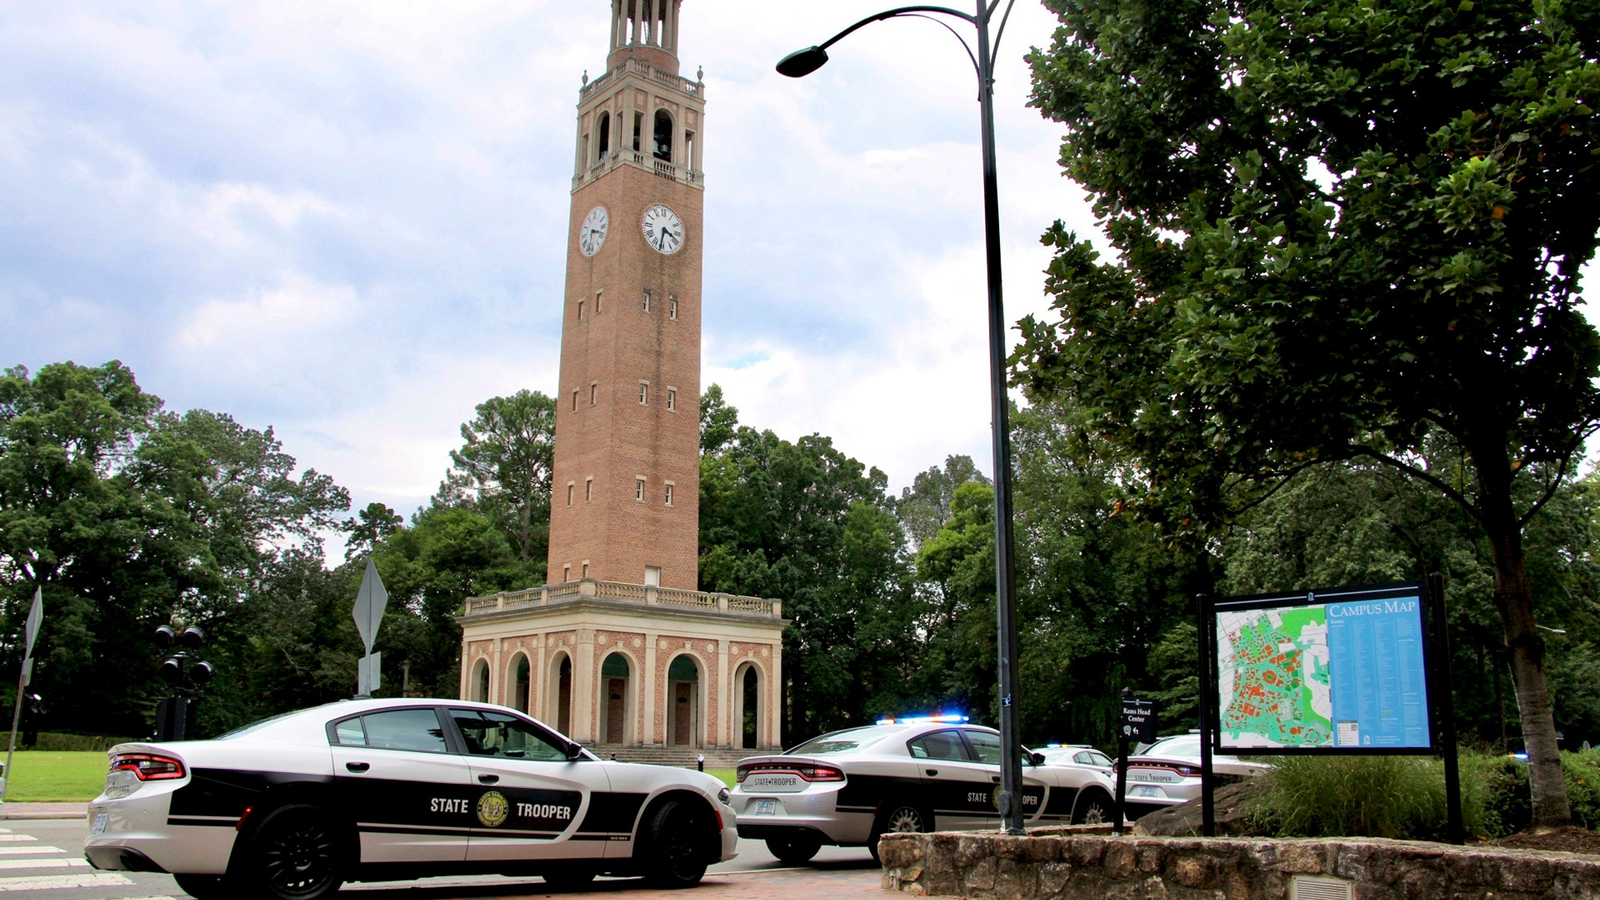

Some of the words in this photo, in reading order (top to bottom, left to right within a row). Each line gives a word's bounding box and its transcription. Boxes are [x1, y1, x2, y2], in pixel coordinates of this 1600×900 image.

[1329, 604, 1382, 618] CAMPUS
[1385, 600, 1415, 613] MAP
[754, 777, 769, 786] STATE
[770, 777, 797, 786] TROOPER
[967, 792, 987, 803] STATE
[1022, 795, 1038, 805] OPER
[430, 797, 469, 813] STATE
[516, 802, 571, 820] TROOPER
